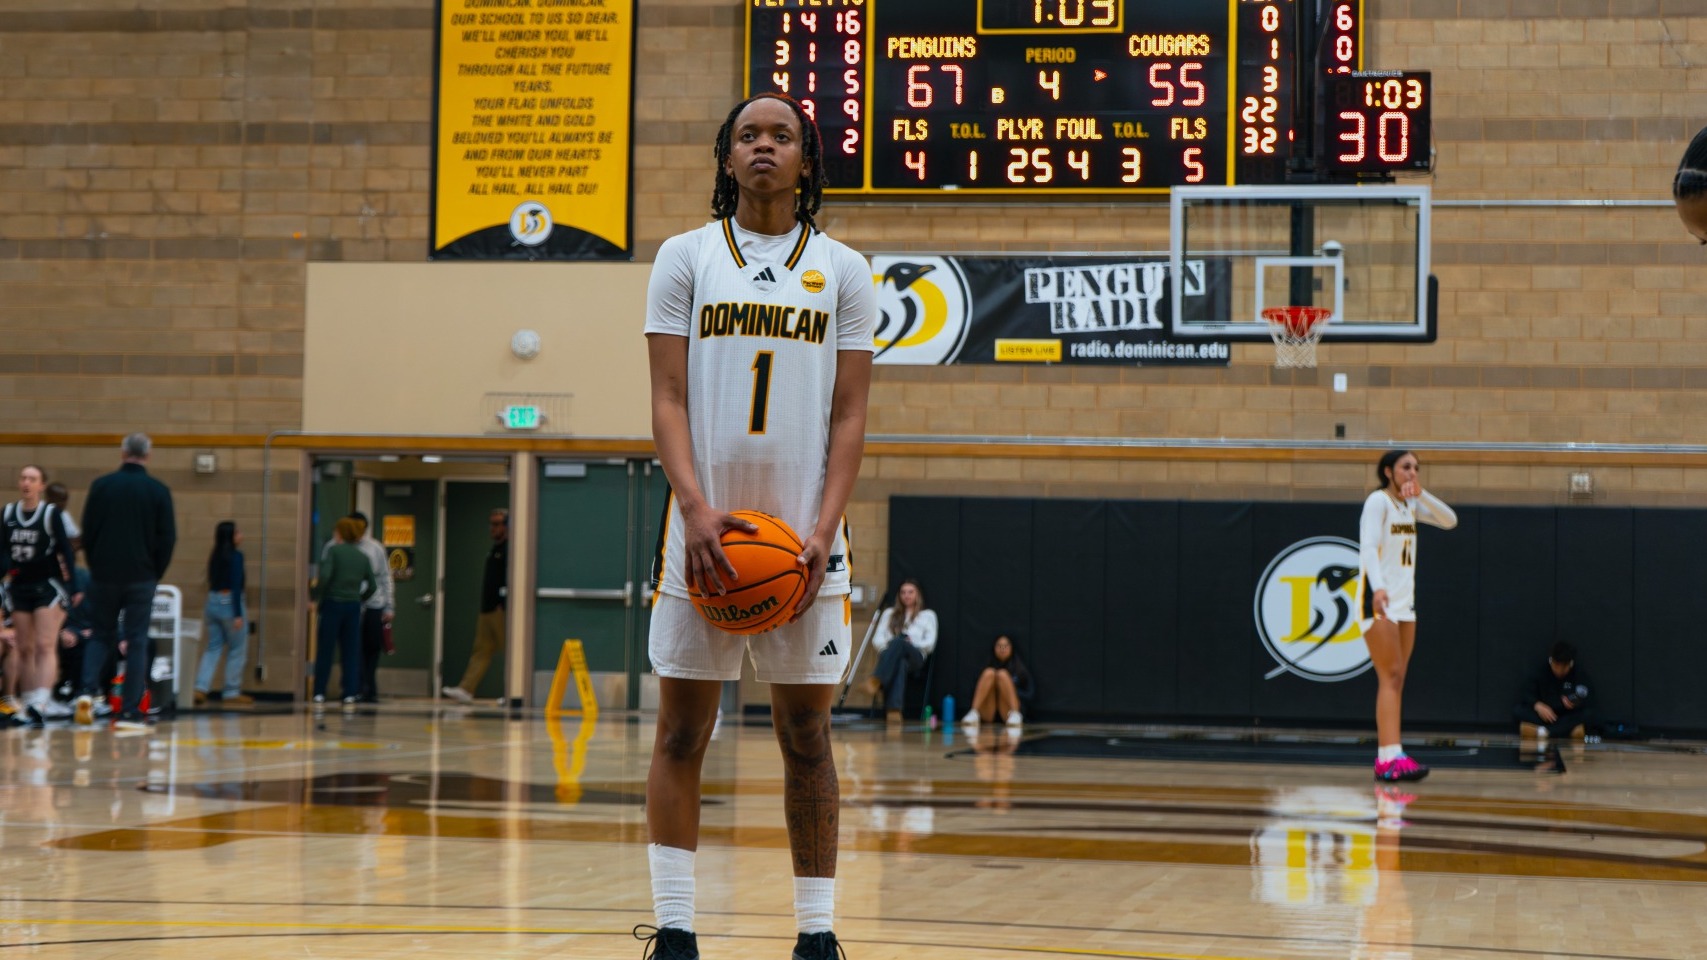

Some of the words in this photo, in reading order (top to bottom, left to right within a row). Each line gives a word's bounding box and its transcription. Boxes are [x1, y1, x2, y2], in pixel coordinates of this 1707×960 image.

[450, 12, 476, 25] OUR
[478, 12, 525, 25] SCHOOL
[529, 12, 545, 25] TO
[546, 12, 564, 25] US
[566, 12, 583, 25] SO
[783, 12, 791, 33] 1
[800, 12, 817, 33] 4
[836, 10, 861, 35] 16
[1262, 5, 1279, 32] 0
[1337, 4, 1353, 31] 6
[462, 30, 496, 42] WE'LL
[498, 30, 540, 42] HONOR
[575, 30, 609, 42] WE'LL
[888, 36, 977, 58] PENGUINS
[1129, 34, 1210, 57] COUGARS
[1271, 38, 1278, 60] 1
[1337, 35, 1353, 62] 0
[495, 46, 548, 58] CHERISH
[550, 46, 576, 58] YOU
[776, 40, 790, 66] 3
[809, 42, 816, 63] 1
[844, 39, 860, 65] 8
[1026, 47, 1077, 64] PERIOD
[458, 62, 514, 76] THROUGH
[516, 62, 536, 76] ALL
[542, 62, 562, 76] THE
[565, 62, 612, 76] FUTURE
[1264, 66, 1278, 93] 3
[772, 71, 790, 93] 4
[808, 71, 816, 93] 1
[844, 69, 860, 95] 5
[908, 64, 963, 108] 67
[1039, 70, 1060, 101] 4
[1149, 62, 1205, 107] 55
[1365, 79, 1422, 110] 1:03
[474, 97, 506, 110] YOUR
[508, 97, 536, 110] FLAG
[539, 97, 594, 110] UNFOLDS
[991, 87, 1004, 104] B
[472, 114, 492, 127] THE
[496, 114, 532, 127] WHITE
[536, 114, 562, 127] AND
[563, 114, 596, 127] GOLD
[843, 98, 859, 122] 9
[1242, 96, 1278, 123] 22
[452, 132, 504, 144] BELOVED
[506, 132, 545, 144] YOU'LL
[548, 132, 594, 144] ALWAYS
[597, 132, 614, 144] BE
[842, 128, 859, 154] 2
[893, 119, 929, 141] FLS
[998, 118, 1044, 140] PLYR
[1056, 118, 1102, 140] FOUL
[1171, 118, 1207, 140] FLS
[1244, 126, 1278, 154] 32
[1340, 112, 1408, 162] 30
[462, 149, 488, 162] AND
[490, 149, 524, 162] FROM
[527, 149, 553, 162] OUR
[555, 149, 602, 162] HEARTS
[905, 150, 926, 180] 4
[969, 150, 978, 181] 1
[1007, 148, 1052, 183] 25
[1068, 150, 1089, 180] 4
[1122, 148, 1141, 183] 3
[1184, 148, 1204, 182] 5
[476, 166, 514, 178] YOU'LL
[517, 166, 555, 178] NEVER
[558, 166, 589, 178] PART
[468, 182, 488, 196] ALL
[524, 182, 544, 196] ALL
[1027, 261, 1202, 300] PENGUN
[699, 302, 830, 345] DOMINICAN
[1070, 341, 1228, 359] radio.dominican.edu
[748, 350, 775, 435] 1
[700, 596, 778, 622] Wilson
